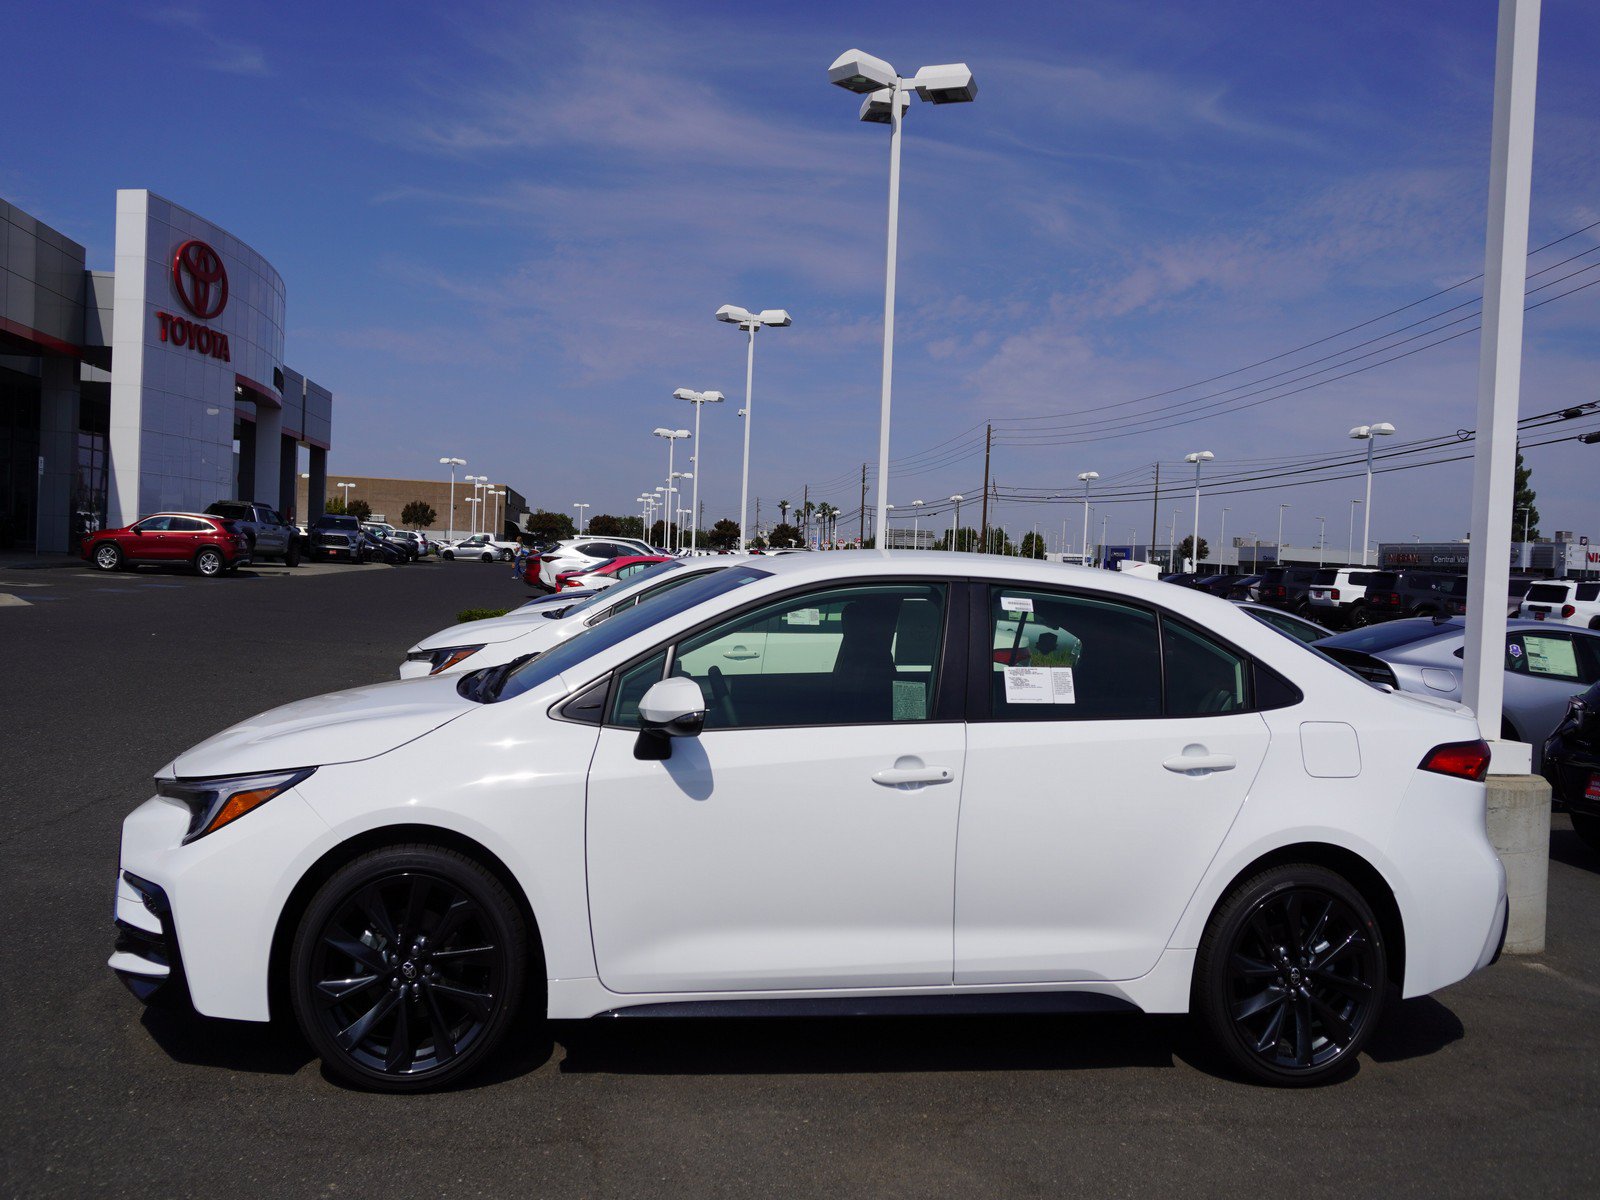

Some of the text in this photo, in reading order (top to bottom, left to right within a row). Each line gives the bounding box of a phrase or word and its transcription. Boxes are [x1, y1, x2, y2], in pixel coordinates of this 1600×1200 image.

[157, 311, 230, 362] TOYOTA
[1433, 555, 1456, 563] Central
[1587, 552, 1600, 563] NI
